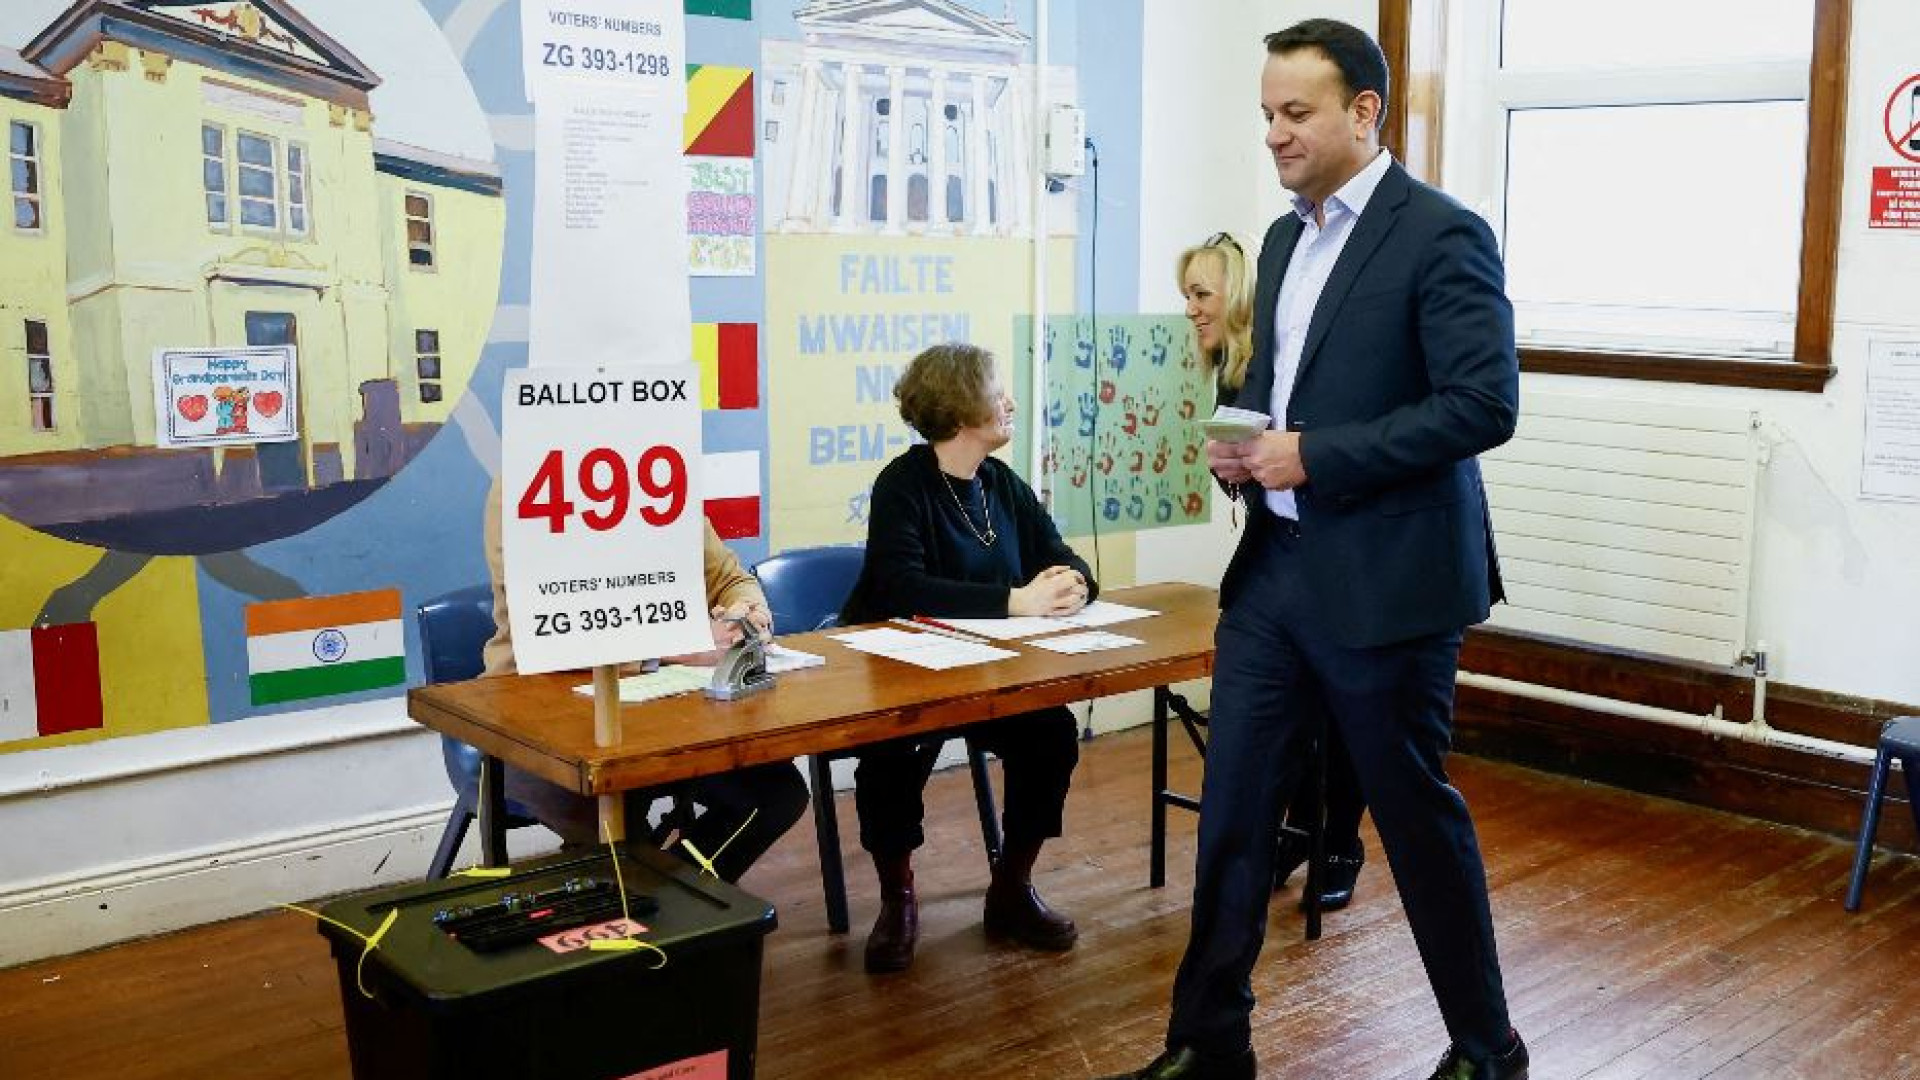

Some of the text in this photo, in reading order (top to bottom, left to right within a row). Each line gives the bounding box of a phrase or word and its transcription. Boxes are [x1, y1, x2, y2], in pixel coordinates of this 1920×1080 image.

[604, 17, 662, 36] NUMBERS
[542, 42, 670, 76] ZG 393-1298
[207, 357, 248, 371] Happy
[518, 380, 687, 406] BALLOT BOX
[517, 444, 688, 534] 499
[538, 571, 676, 595] VOTERS' NUMBERS
[534, 600, 687, 637] ZG 393-1298
